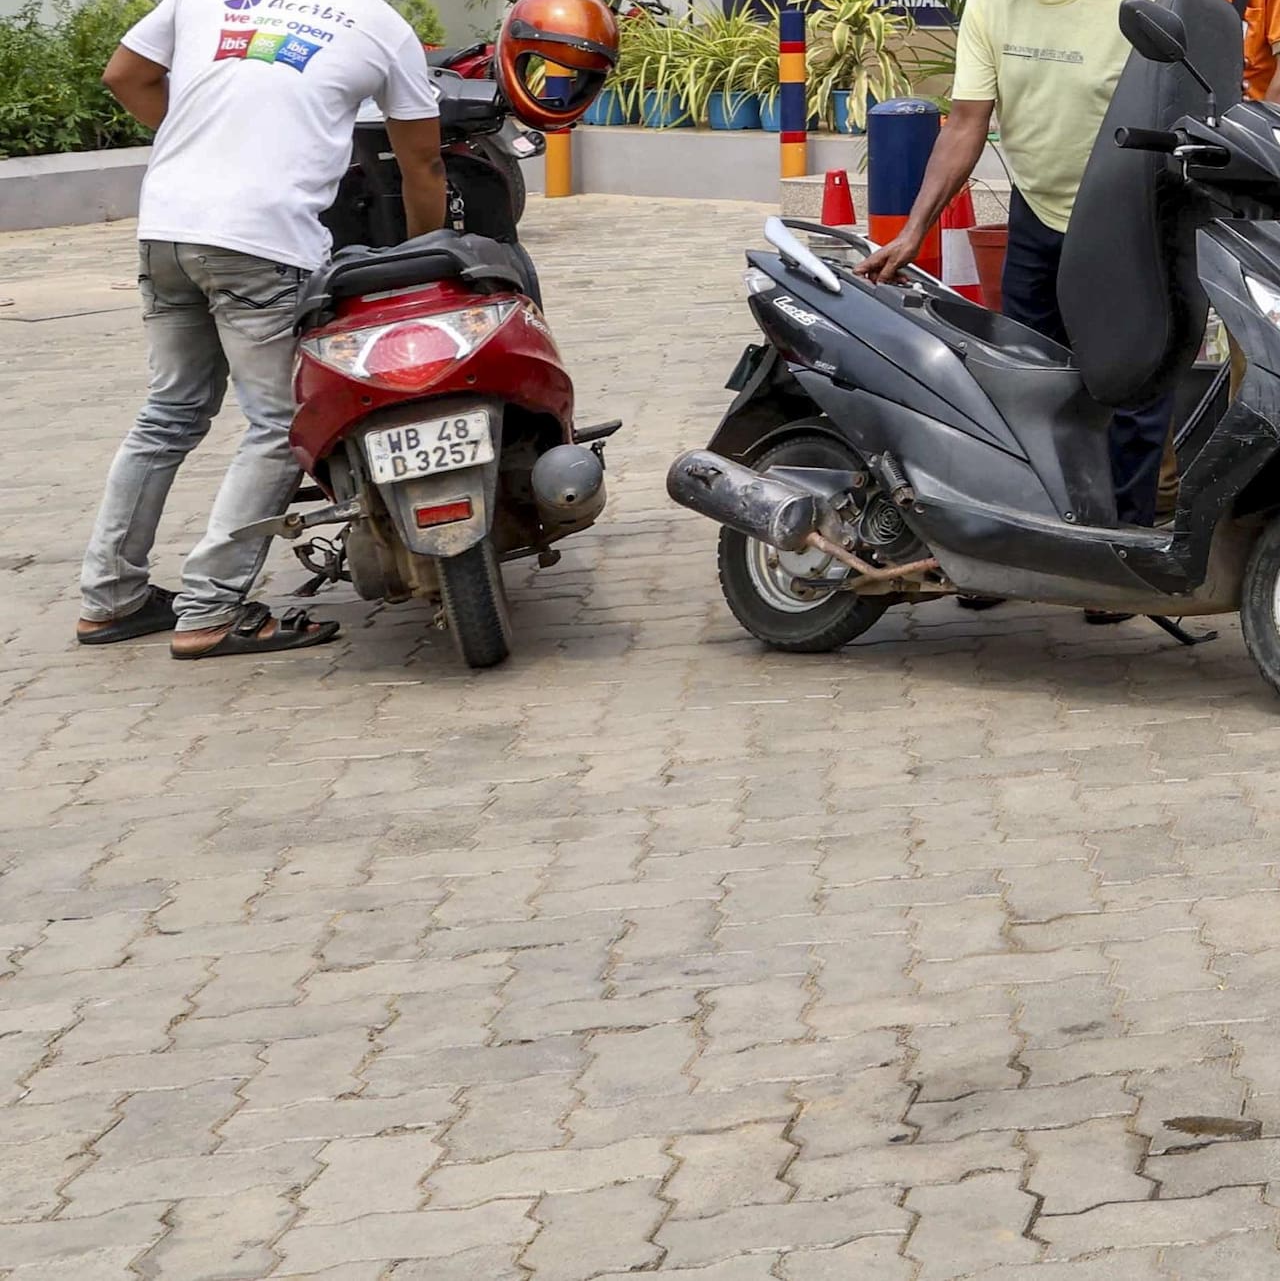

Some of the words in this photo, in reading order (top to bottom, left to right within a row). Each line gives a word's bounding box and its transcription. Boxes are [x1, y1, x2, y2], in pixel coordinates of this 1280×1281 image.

[224, 13, 250, 24] we
[253, 16, 283, 26] are
[286, 21, 334, 43] open
[221, 38, 248, 50] ibis
[287, 41, 309, 56] ibis
[387, 428, 421, 454] WB
[437, 419, 469, 442] 48
[416, 440, 480, 471] 3257
